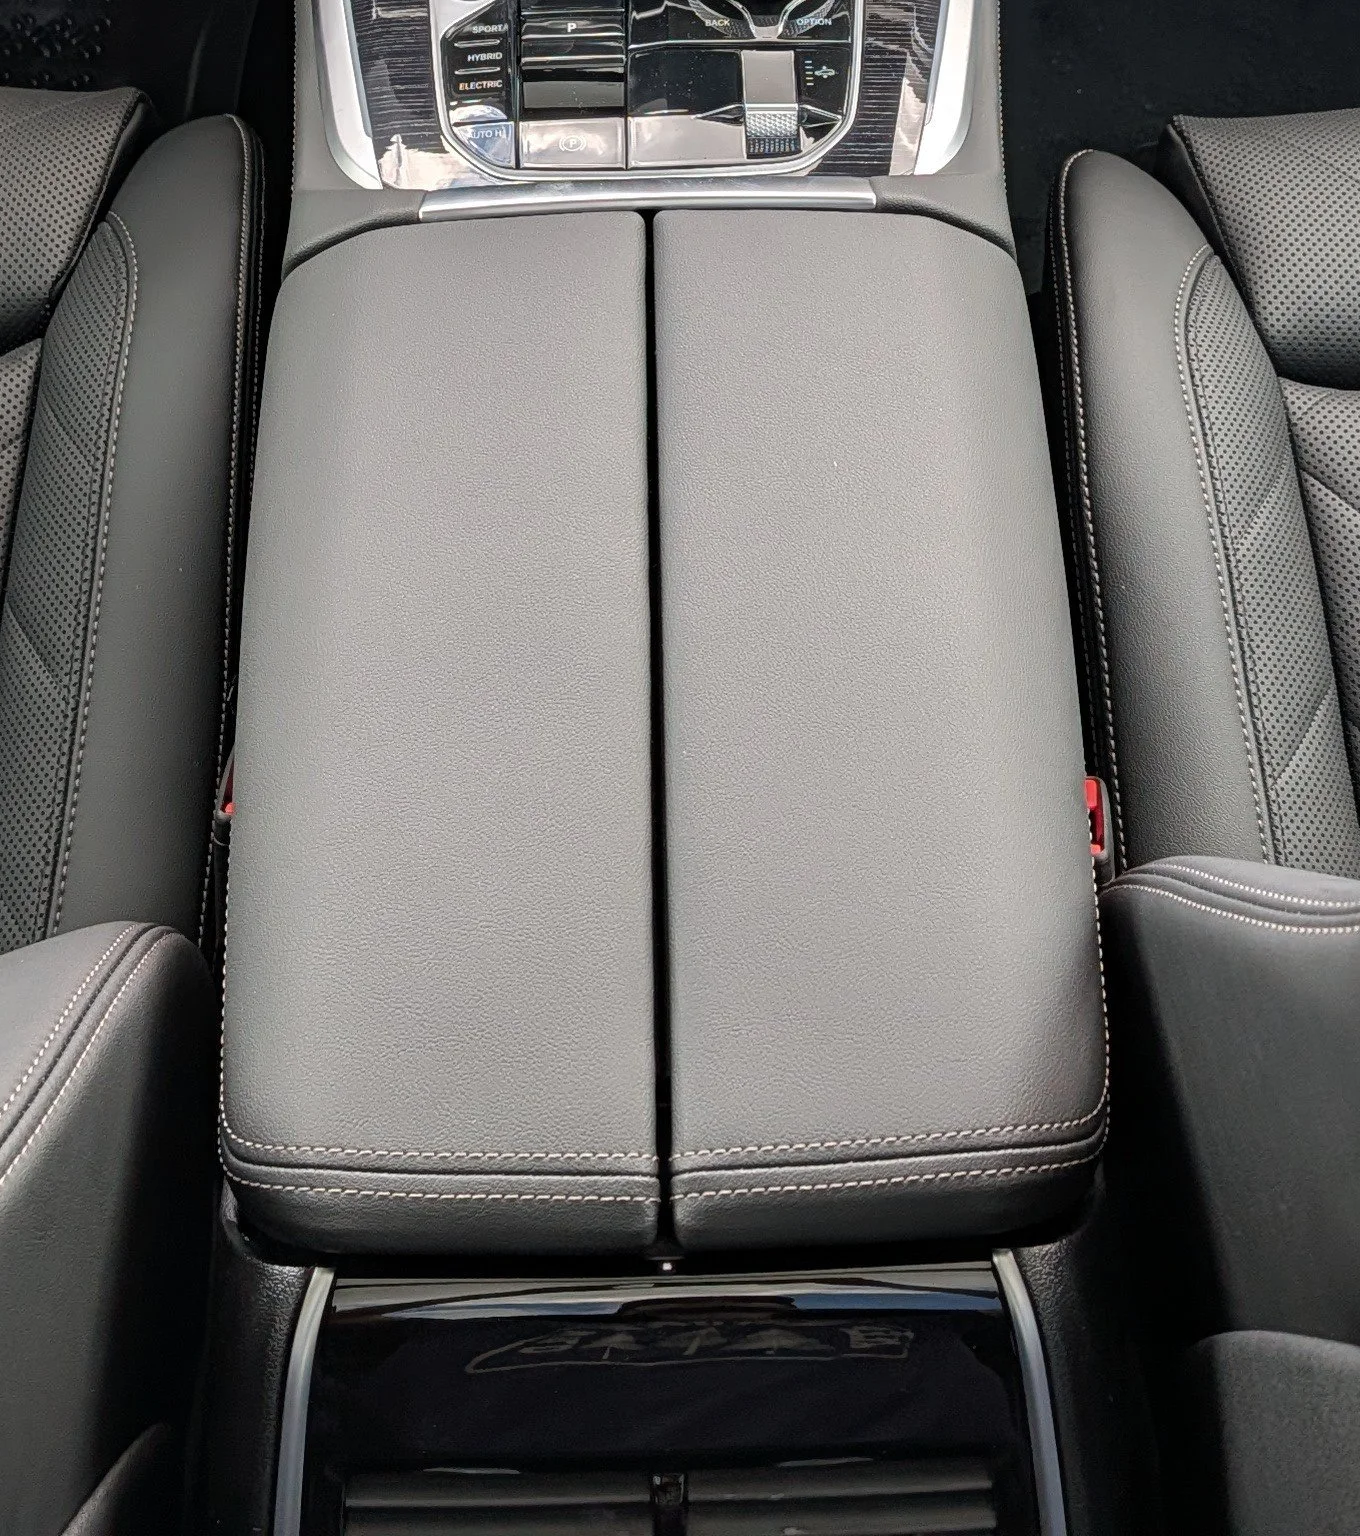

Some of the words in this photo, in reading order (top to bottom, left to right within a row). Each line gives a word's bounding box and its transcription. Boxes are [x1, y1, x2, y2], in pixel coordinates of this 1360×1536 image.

[705, 19, 731, 27] BACK
[796, 18, 833, 26] OPTION
[567, 23, 577, 33] P
[467, 52, 503, 62] HYBRID
[458, 80, 503, 91] ELECTRIC
